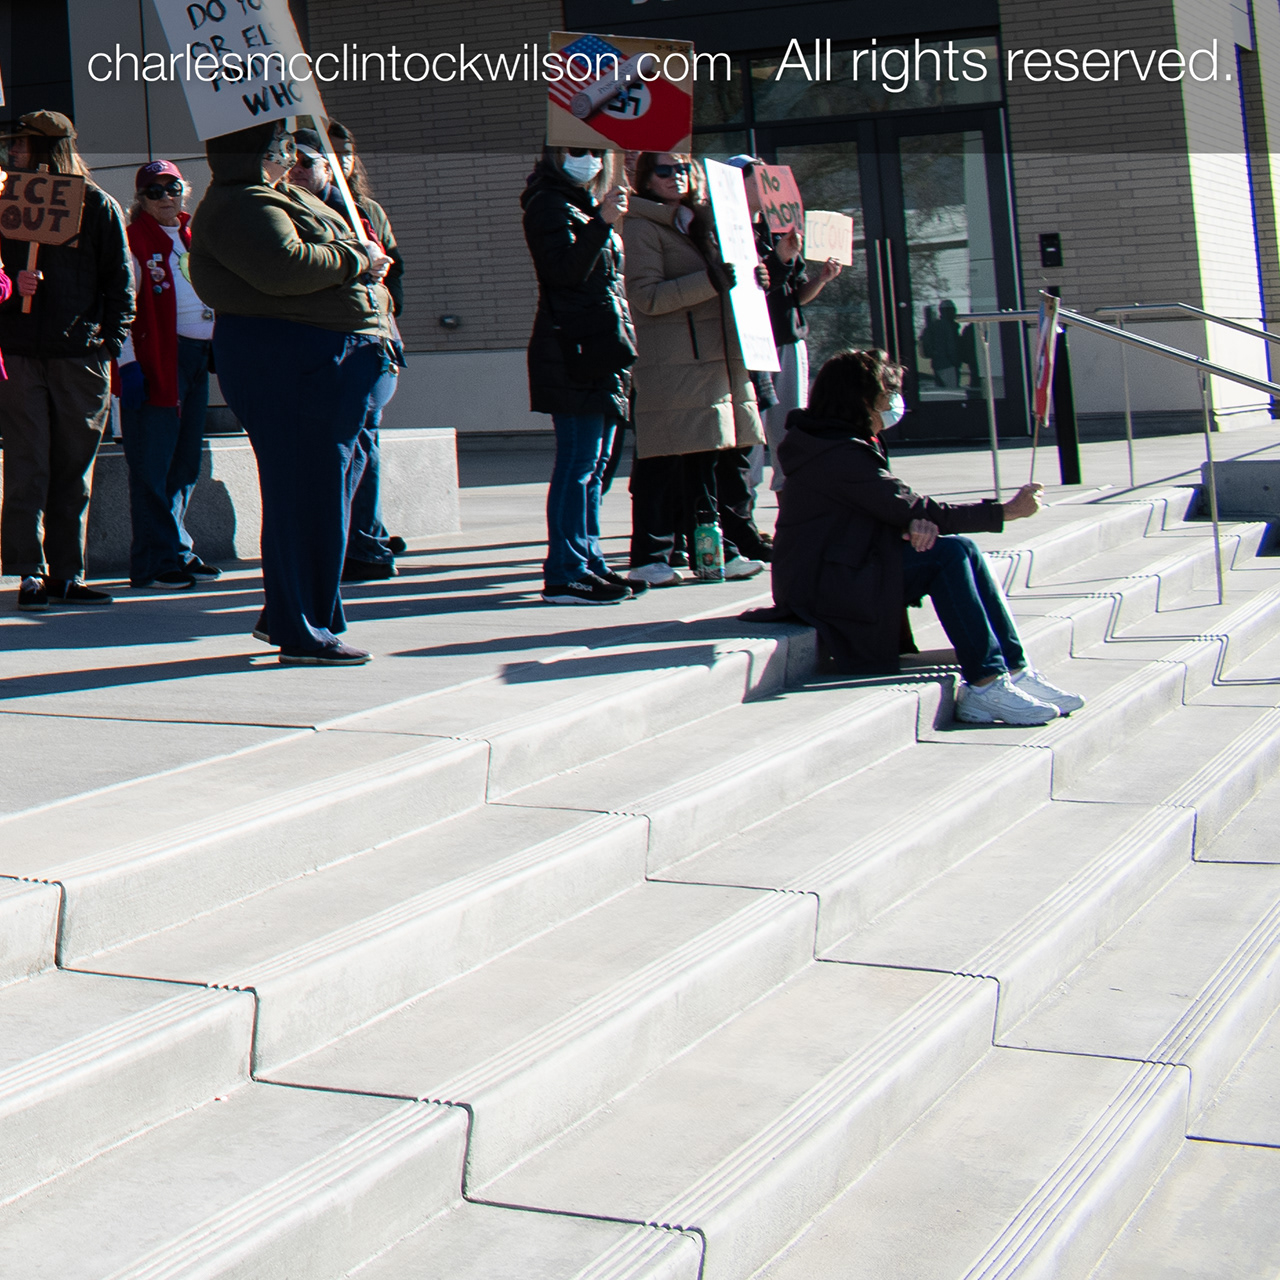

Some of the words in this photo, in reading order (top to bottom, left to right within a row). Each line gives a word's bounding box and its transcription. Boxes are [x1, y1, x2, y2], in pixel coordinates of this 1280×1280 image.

[190, 34, 233, 62] OR
[241, 78, 304, 117] WHO
[0, 173, 73, 207] ICE
[0, 204, 71, 234] OUT
